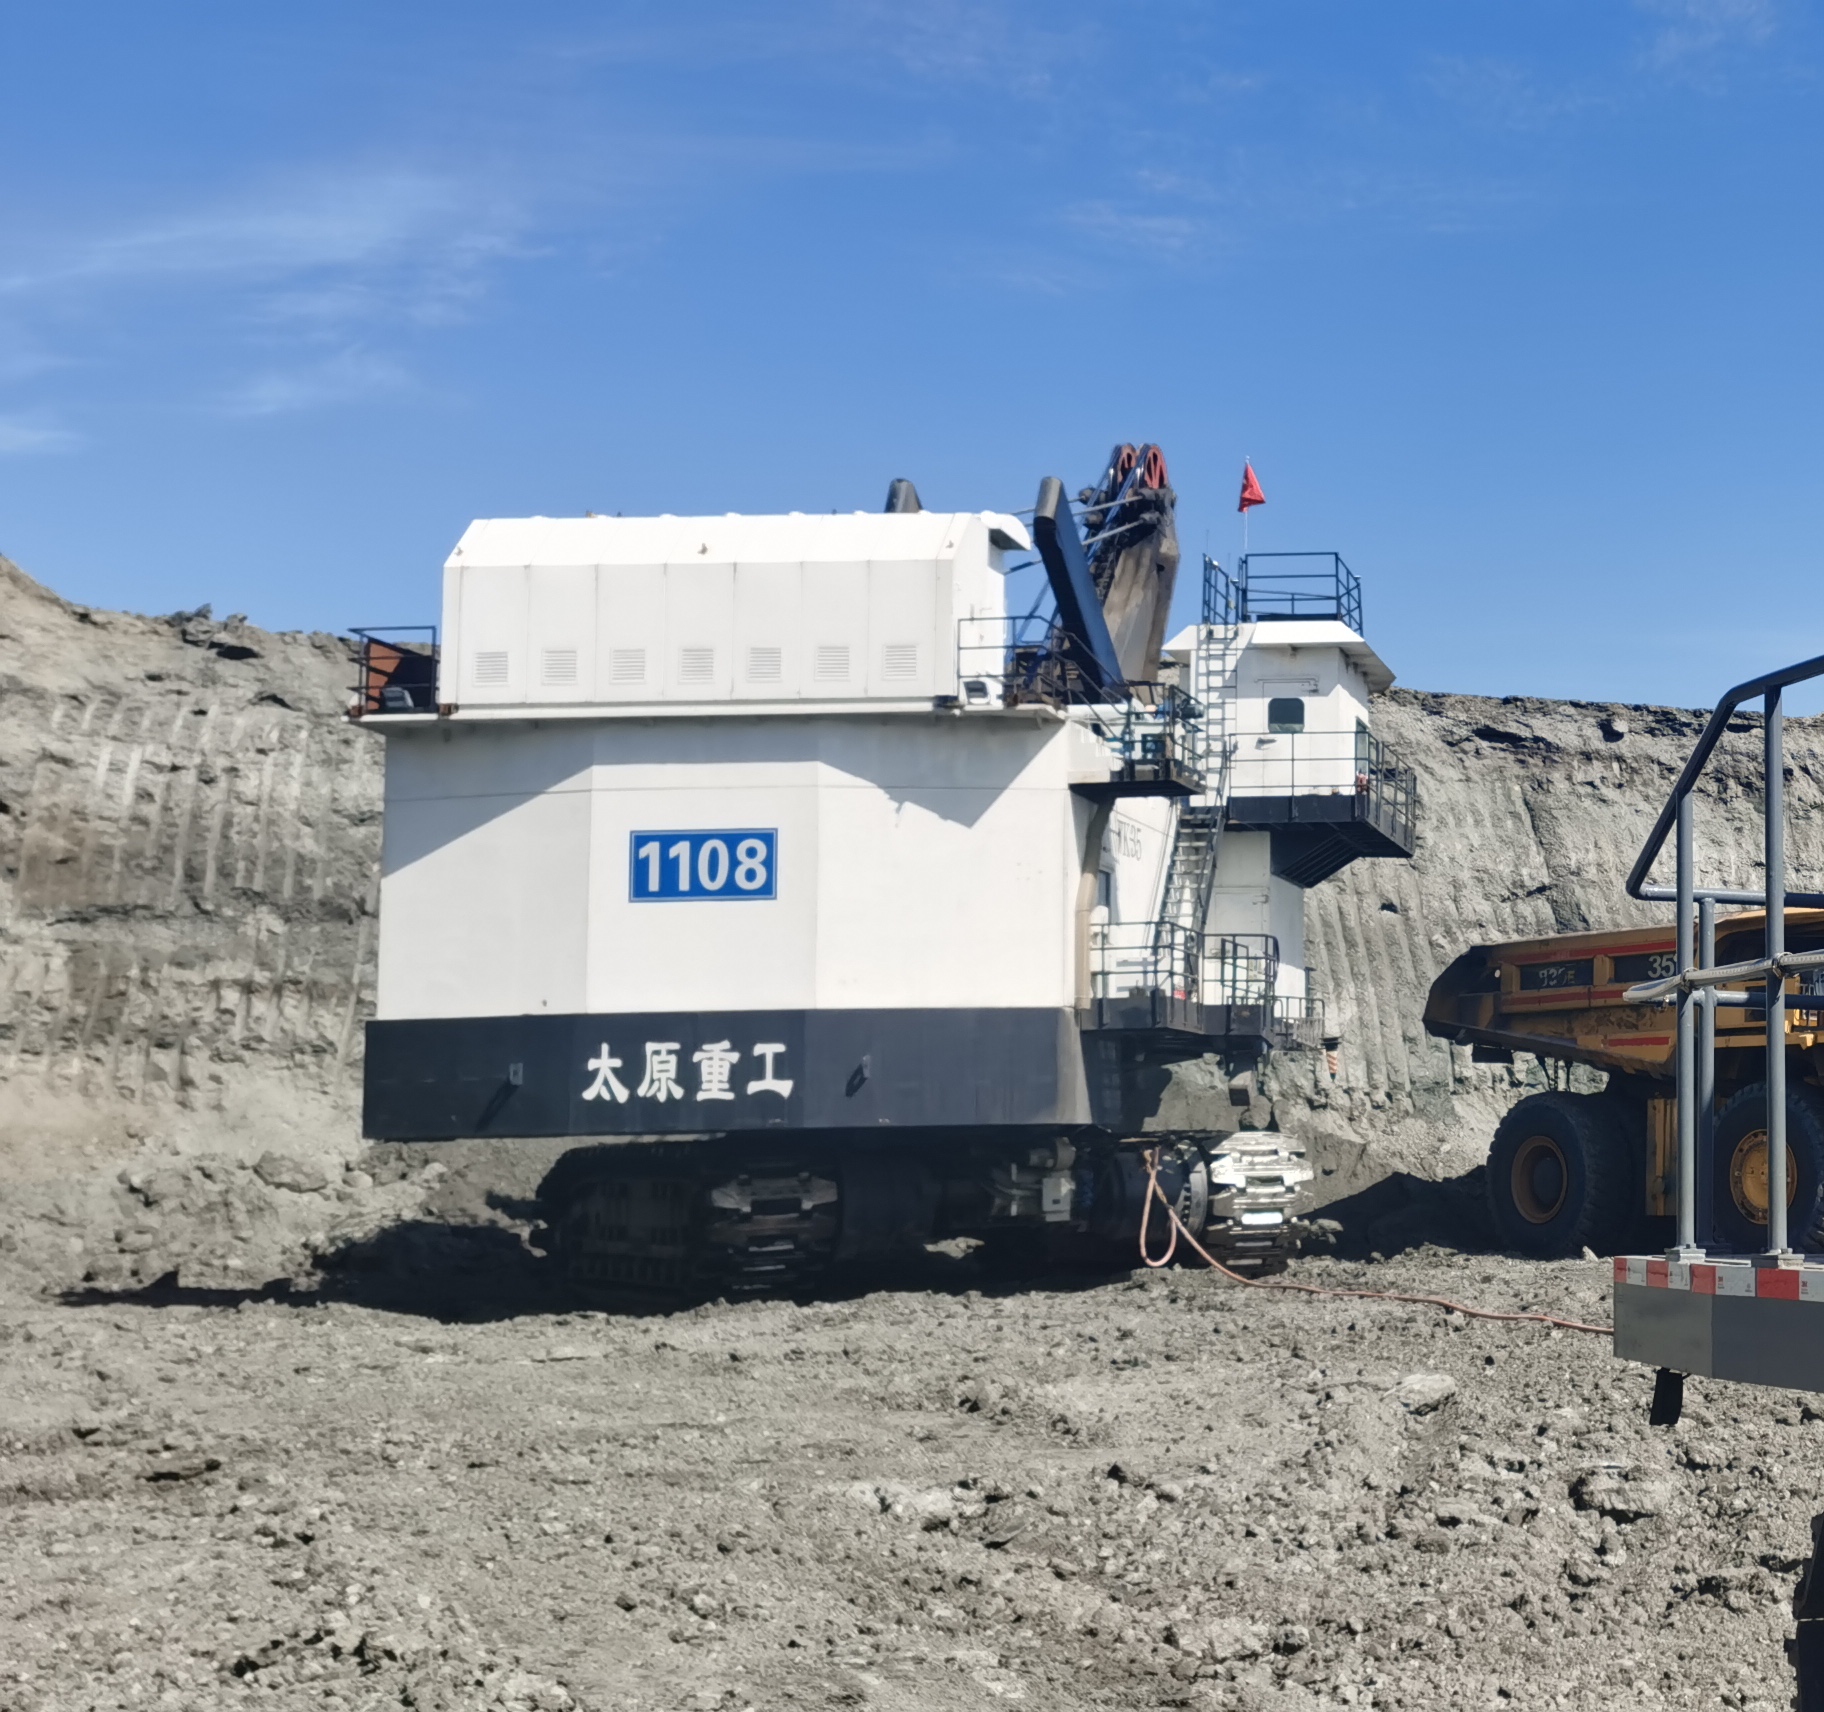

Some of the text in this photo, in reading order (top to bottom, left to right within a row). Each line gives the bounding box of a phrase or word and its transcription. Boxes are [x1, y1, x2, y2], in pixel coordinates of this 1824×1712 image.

[638, 839, 768, 892] 1108
[1647, 953, 1677, 979] 35
[582, 1040, 794, 1103] 太原重工
